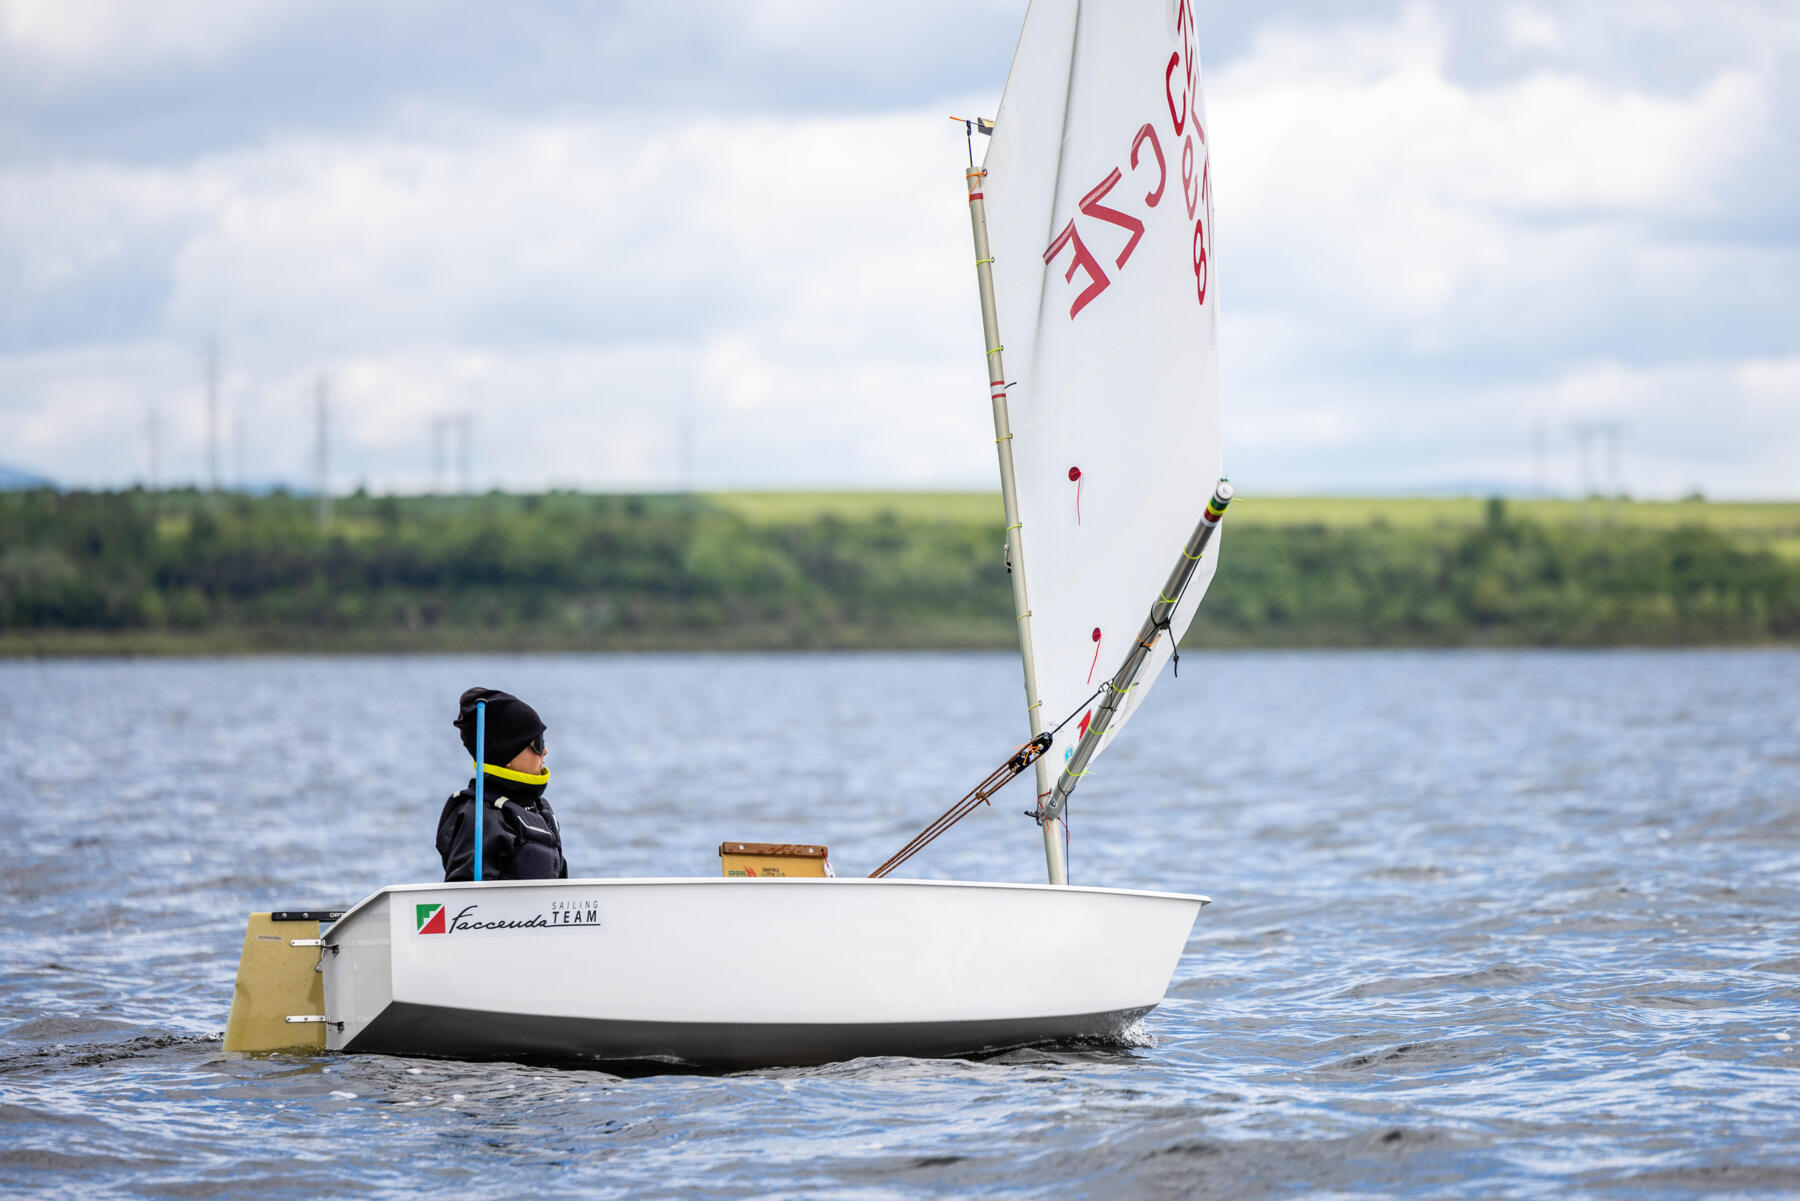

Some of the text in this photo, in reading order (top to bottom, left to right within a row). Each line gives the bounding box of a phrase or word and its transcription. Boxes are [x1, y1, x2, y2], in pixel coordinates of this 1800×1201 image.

[552, 900, 599, 910] SAILING
[448, 905, 598, 934] Faccenda TEAM
